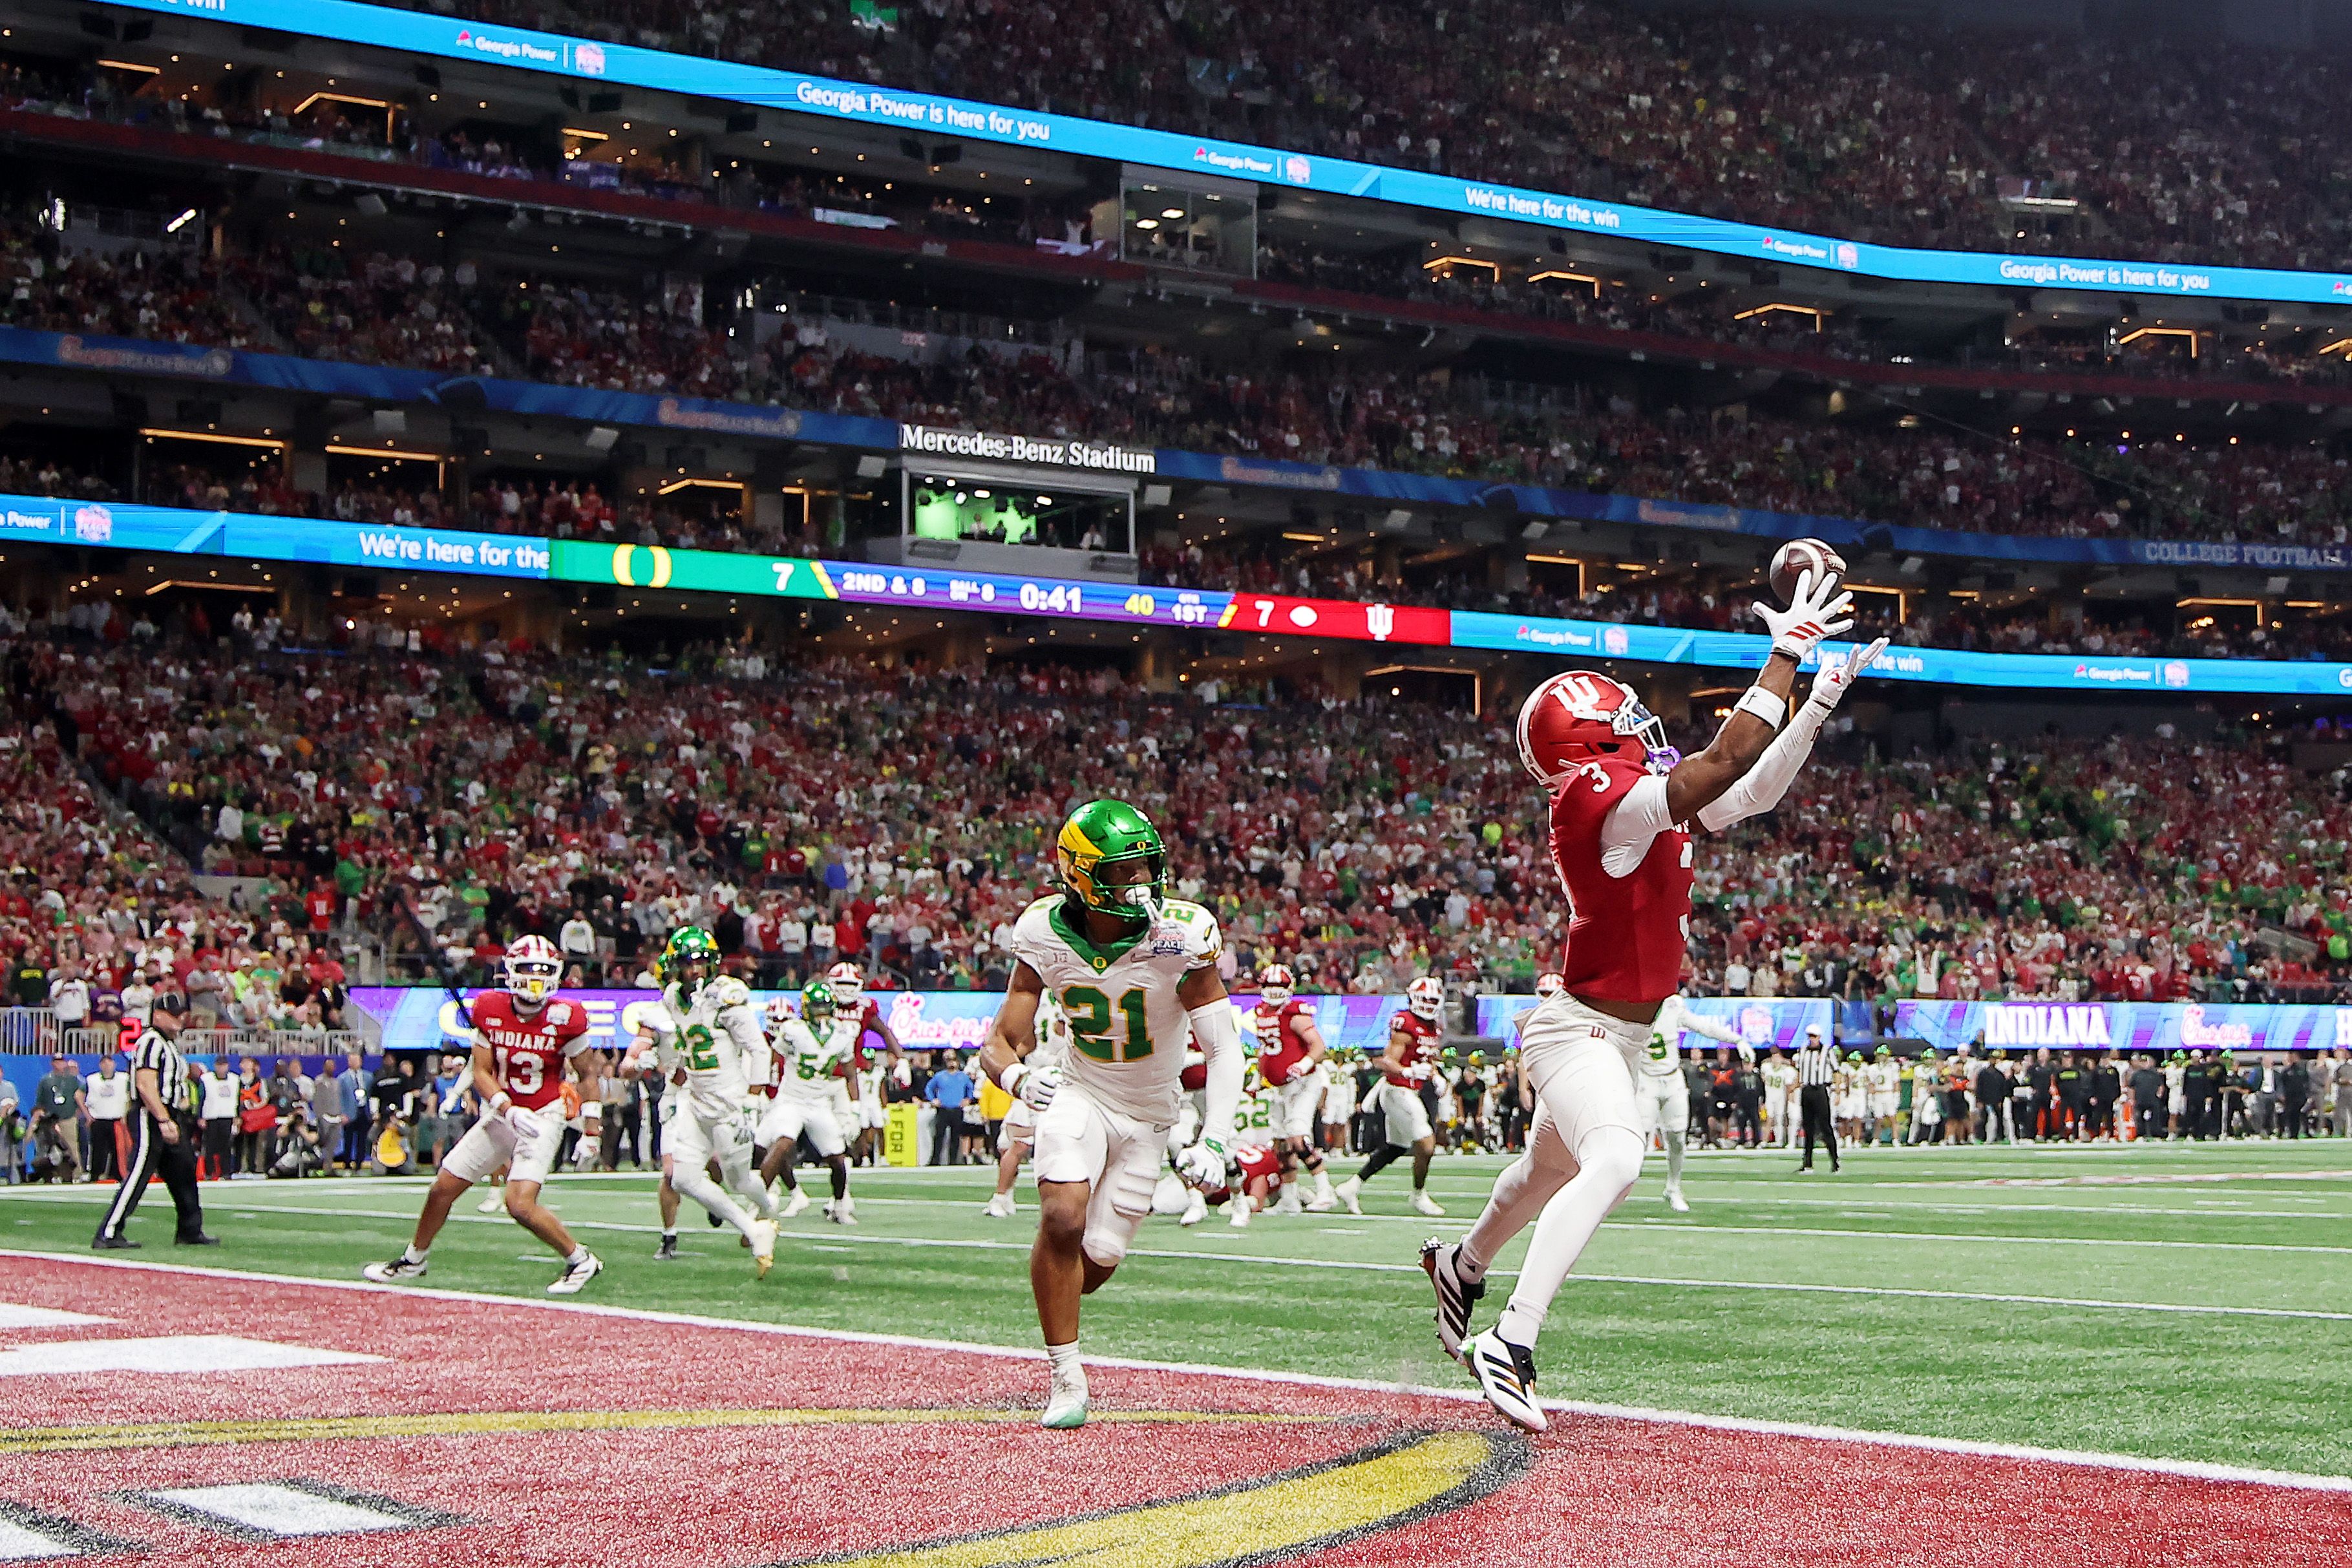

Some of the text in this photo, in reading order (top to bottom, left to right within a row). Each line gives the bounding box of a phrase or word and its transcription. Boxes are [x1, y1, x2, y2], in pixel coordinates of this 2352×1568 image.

[475, 36, 518, 58] Georgia
[520, 43, 556, 61] Power
[796, 81, 1051, 141] Georgia Power is here for you
[1465, 187, 1620, 229] We're here for the win
[2000, 260, 2210, 291] Georgia Power is here for you
[902, 423, 1156, 473] Mercedes-Benz Stadium
[7, 511, 51, 529] Power
[359, 531, 550, 569] We're here for the
[2145, 542, 2347, 567] COLLEGE FOOTBALL
[772, 562, 795, 591] 7
[842, 572, 926, 597] 2ND & 8
[981, 582, 995, 602] 8
[1019, 582, 1083, 613] 0:41
[1125, 593, 1155, 616] 40
[1171, 602, 1208, 623] 1ST
[1255, 600, 1275, 627] 7
[1897, 655, 1923, 673] win
[1580, 761, 1611, 793] 3
[1061, 985, 1156, 1063] 21
[1984, 1006, 2111, 1044] INDIANA
[487, 1028, 556, 1051] INDIANA
[496, 1045, 545, 1094] 13
